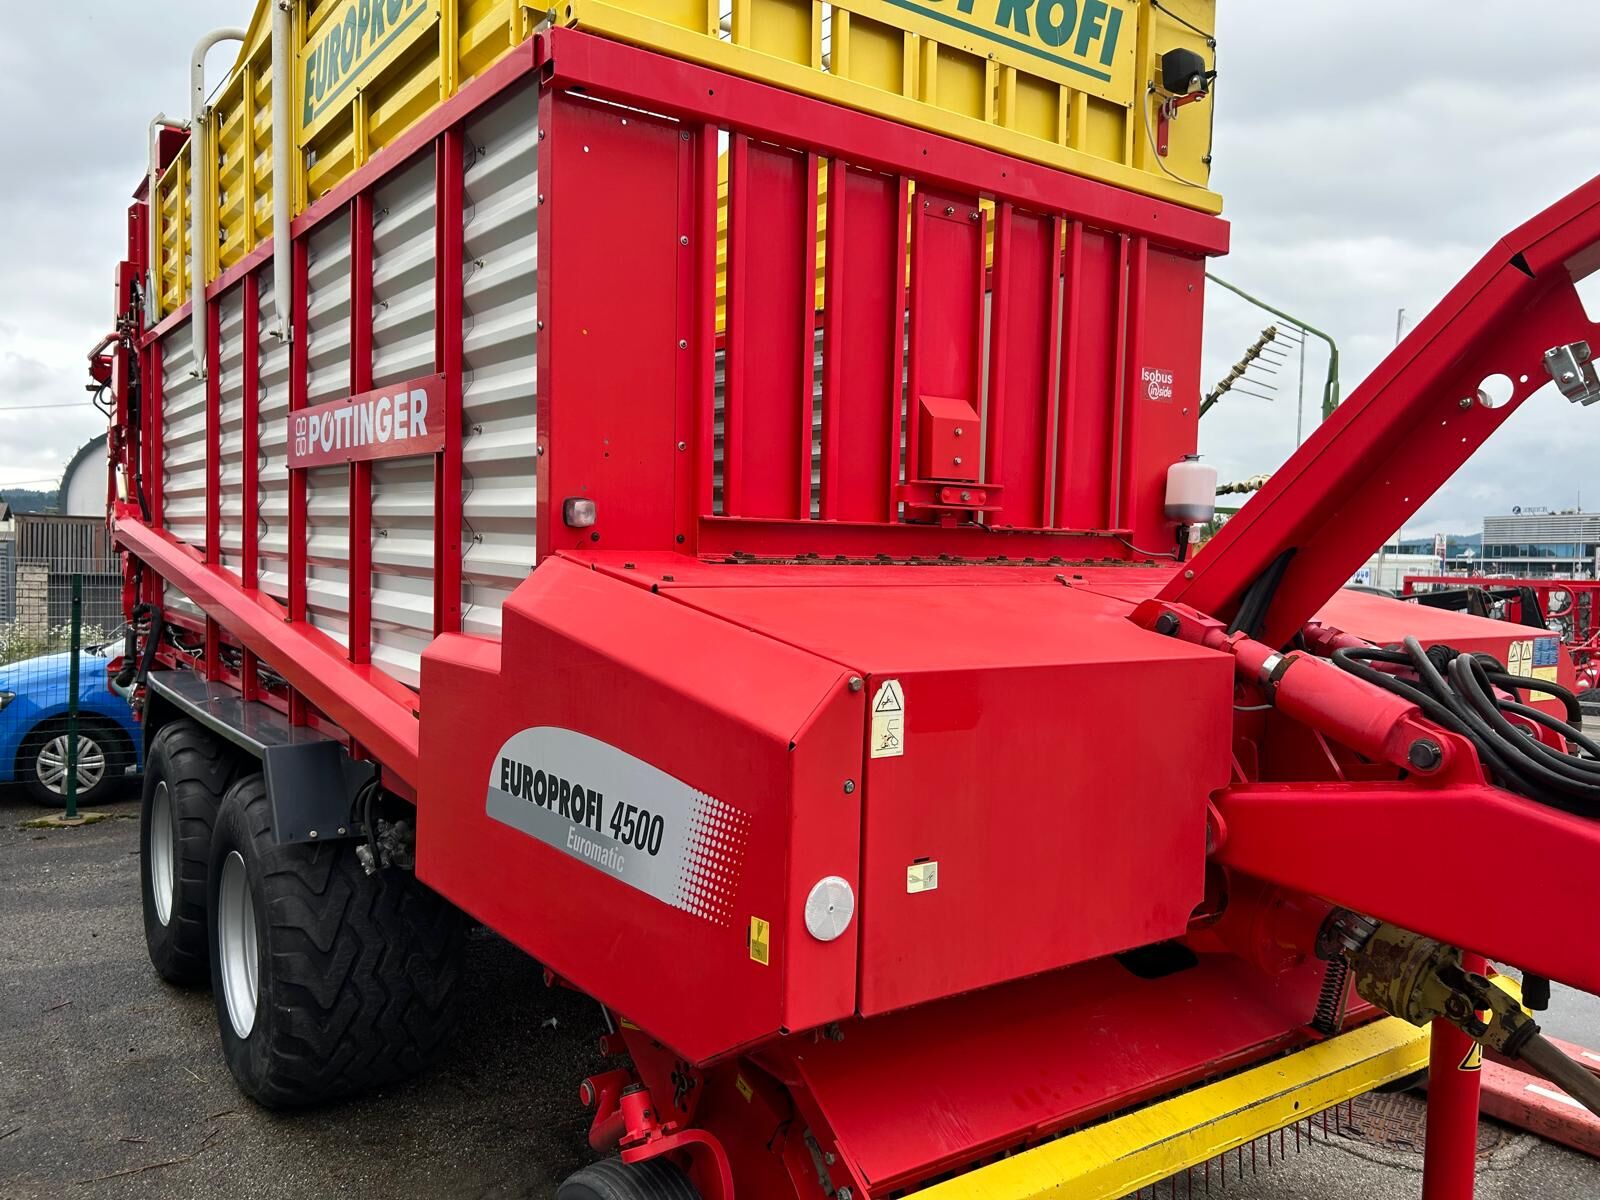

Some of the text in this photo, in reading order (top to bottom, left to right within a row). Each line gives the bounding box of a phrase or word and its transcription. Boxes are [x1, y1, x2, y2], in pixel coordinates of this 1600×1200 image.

[303, 0, 413, 129] EUROPR
[308, 388, 428, 454] PÖTTINGER
[500, 757, 664, 857] EUROPROFI 4500
[566, 825, 625, 874] Euromatic
